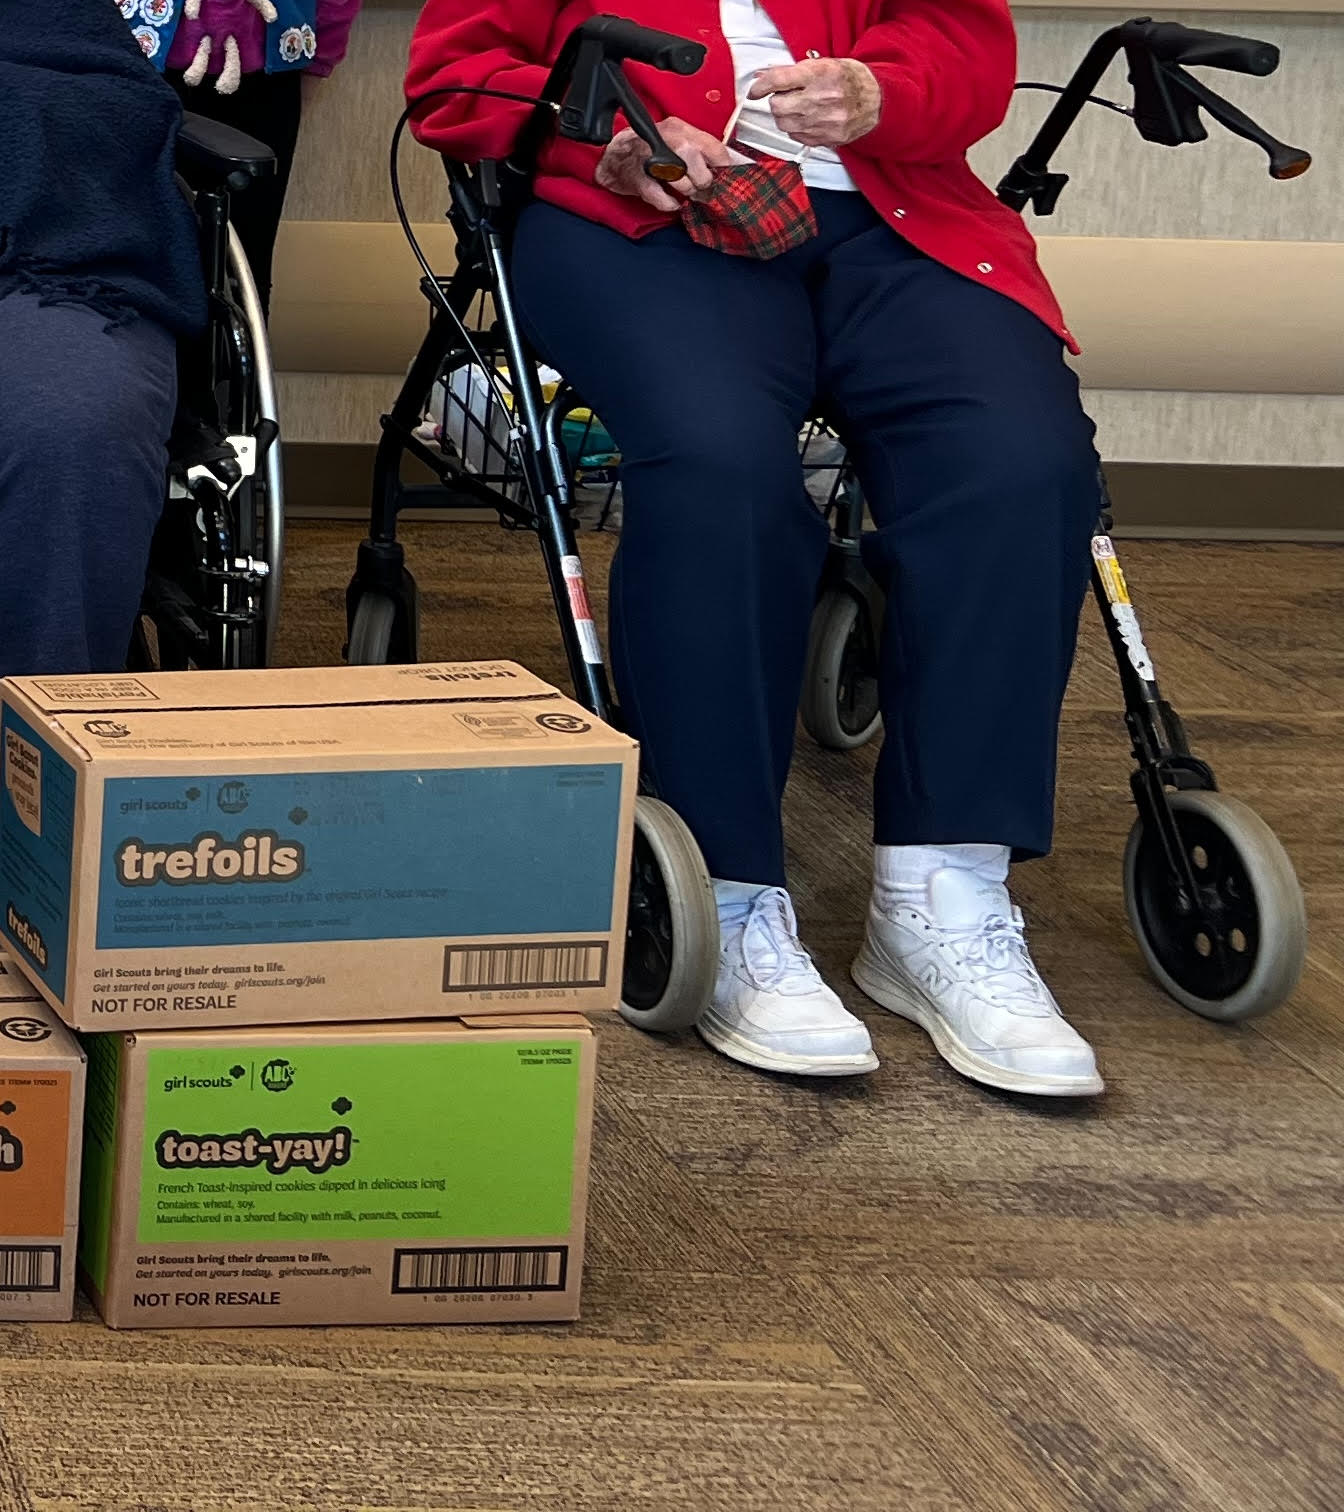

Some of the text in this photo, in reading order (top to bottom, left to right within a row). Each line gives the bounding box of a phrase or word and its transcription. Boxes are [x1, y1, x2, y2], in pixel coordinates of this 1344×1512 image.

[120, 799, 187, 815] girl scouts
[120, 836, 299, 881] trefoils
[7, 906, 46, 965] trefoils
[92, 995, 237, 1014] NOT FOR RESALE
[164, 1077, 232, 1092] girl scouts
[163, 1132, 345, 1168] toast-yay!
[158, 1183, 194, 1193] French
[198, 1183, 272, 1193] Toast-inspired
[275, 1182, 315, 1192] cookies
[319, 1181, 355, 1192] dipped
[359, 1179, 368, 1189] in
[371, 1178, 418, 1189] delicious
[134, 1292, 280, 1307] NOT FOR RESALE
